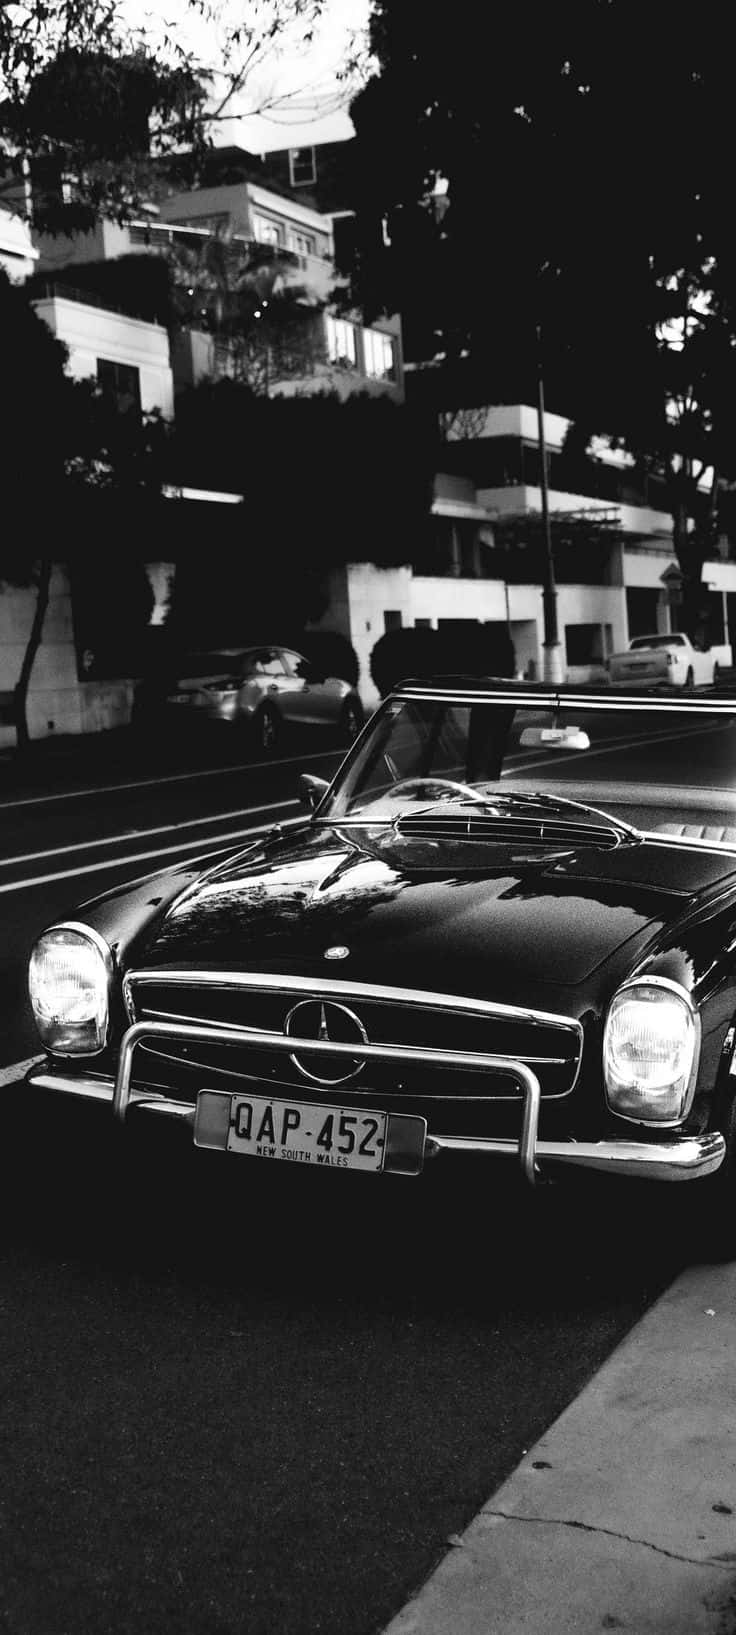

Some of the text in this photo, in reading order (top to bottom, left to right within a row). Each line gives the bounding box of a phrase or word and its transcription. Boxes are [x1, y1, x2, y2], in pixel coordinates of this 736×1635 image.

[256, 1145, 348, 1167] NEW SOUTH WALES
